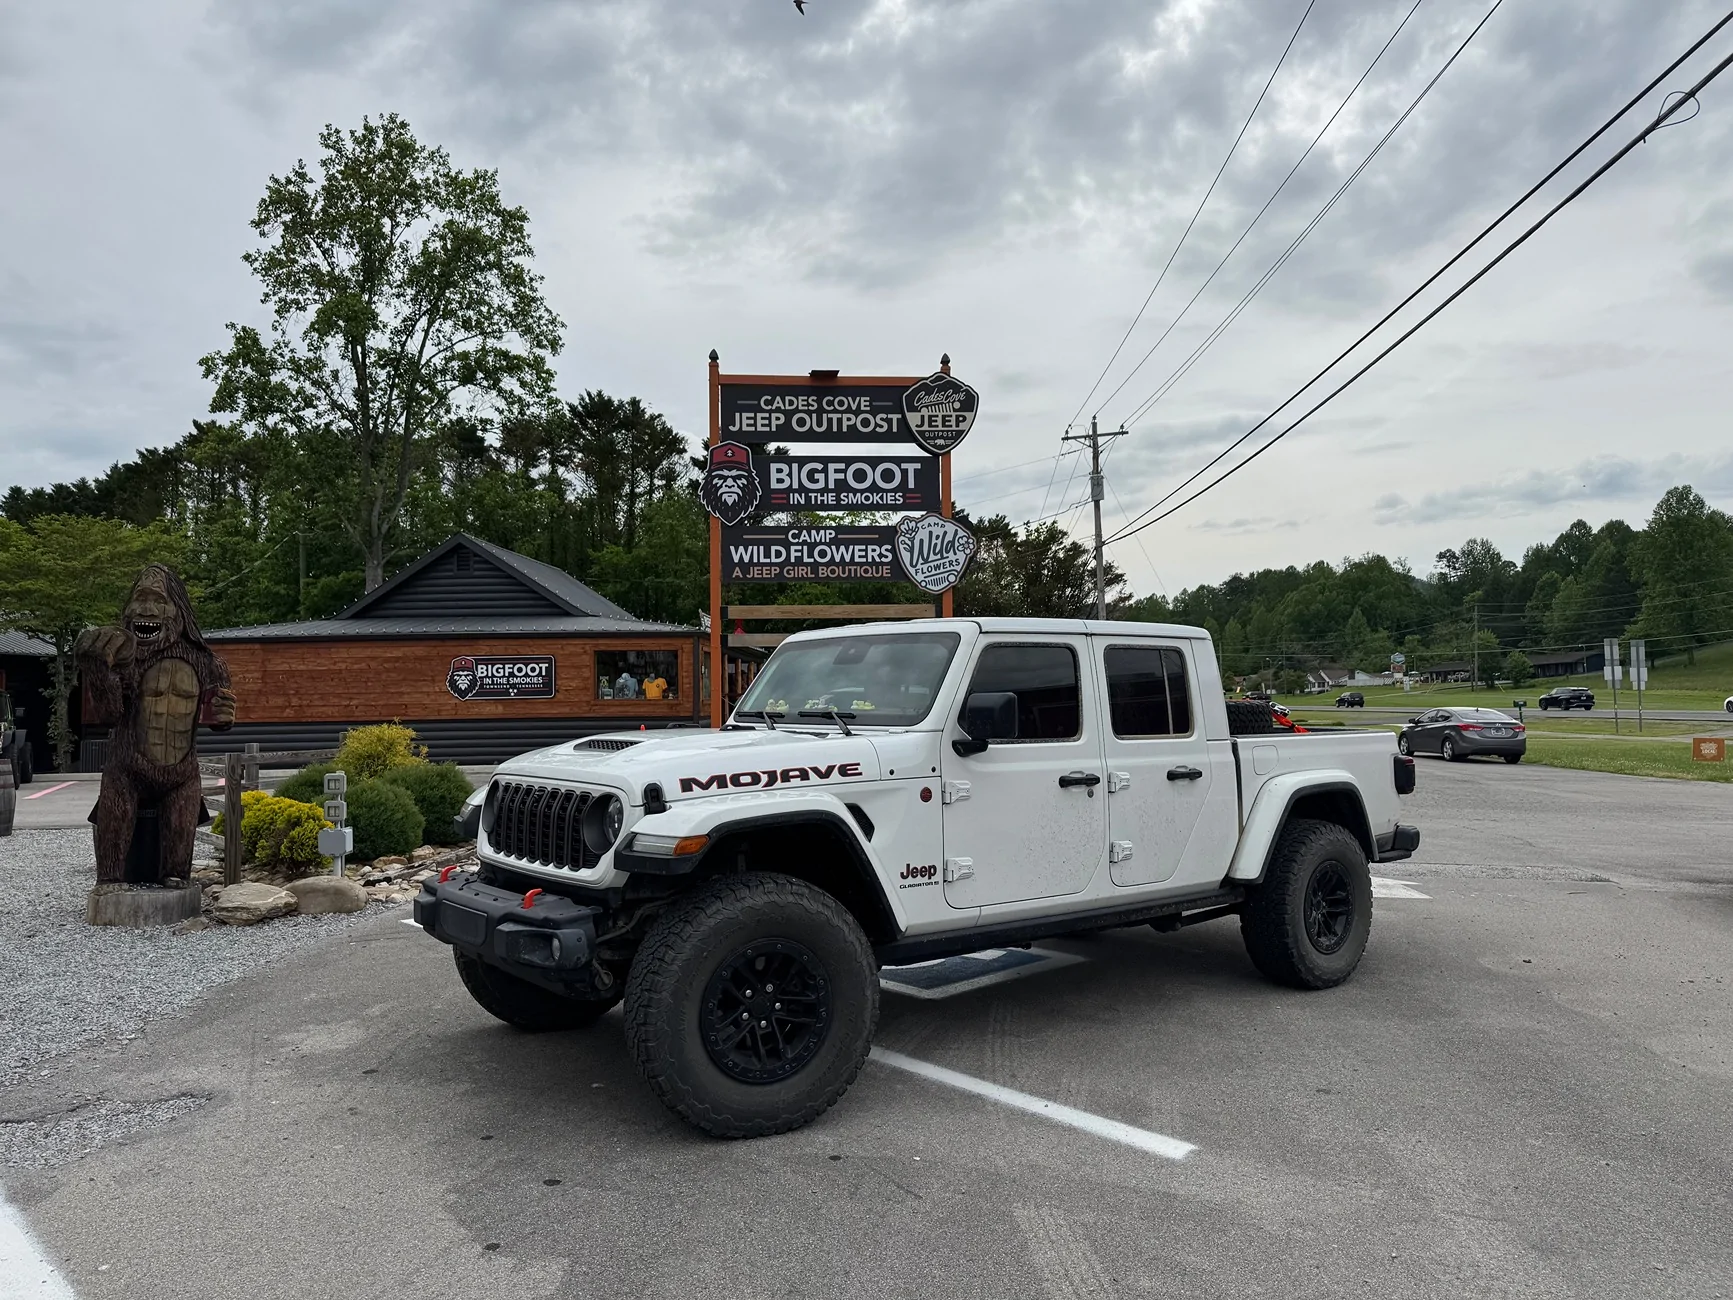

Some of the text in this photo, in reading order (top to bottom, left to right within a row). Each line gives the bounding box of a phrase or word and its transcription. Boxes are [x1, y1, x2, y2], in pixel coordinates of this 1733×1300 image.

[760, 395, 870, 411] CADES COVE
[914, 388, 966, 406] Cades Cove
[728, 413, 902, 433] JEEP OUTPOST
[915, 414, 967, 428] JEEP
[769, 462, 921, 490] BIGFOOT
[789, 492, 904, 505] IN THE SMOKIES
[921, 522, 946, 530] CAMP
[787, 529, 836, 544] CAMP
[729, 545, 893, 563] WILD FLOWERS
[910, 528, 959, 568] Wild
[732, 565, 891, 579] A JEEP GIRL BOUTIQUE
[914, 558, 961, 576] FLOWERS
[477, 663, 549, 677] BIGFOOT
[509, 676, 543, 684] SMOKIES
[678, 762, 863, 793] MOJAVE
[899, 863, 937, 880] Jeep
[899, 881, 934, 890] GLADIATOR
